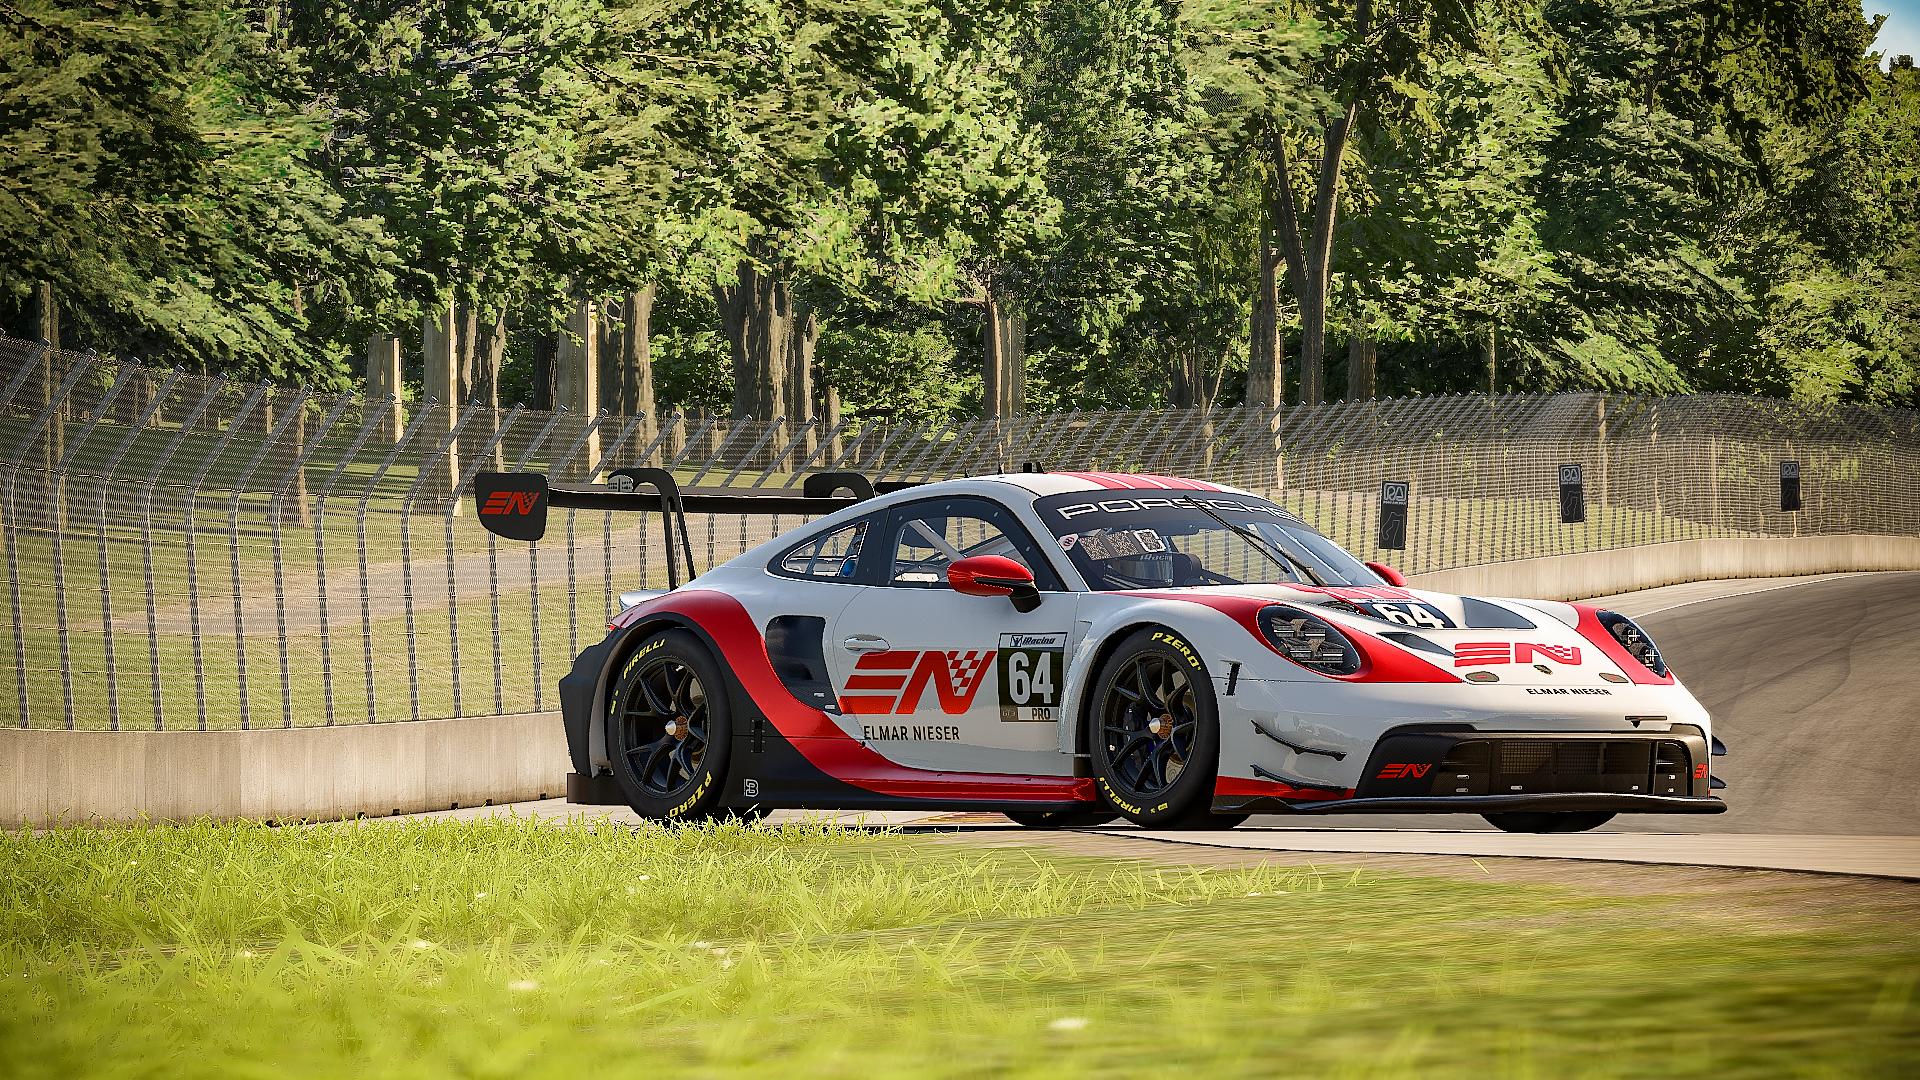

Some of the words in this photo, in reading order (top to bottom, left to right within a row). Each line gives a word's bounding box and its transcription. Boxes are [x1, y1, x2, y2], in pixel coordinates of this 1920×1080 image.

[1056, 498, 1304, 524] PORSCHE
[1371, 603, 1446, 629] 64
[1022, 636, 1056, 646] iRacing
[623, 638, 666, 680] PIRELLI
[1008, 651, 1054, 705] 64
[1570, 688, 1612, 696] NIESER
[1031, 707, 1051, 720] PRO
[863, 725, 909, 741] ELMAR
[913, 725, 960, 741] NIESER
